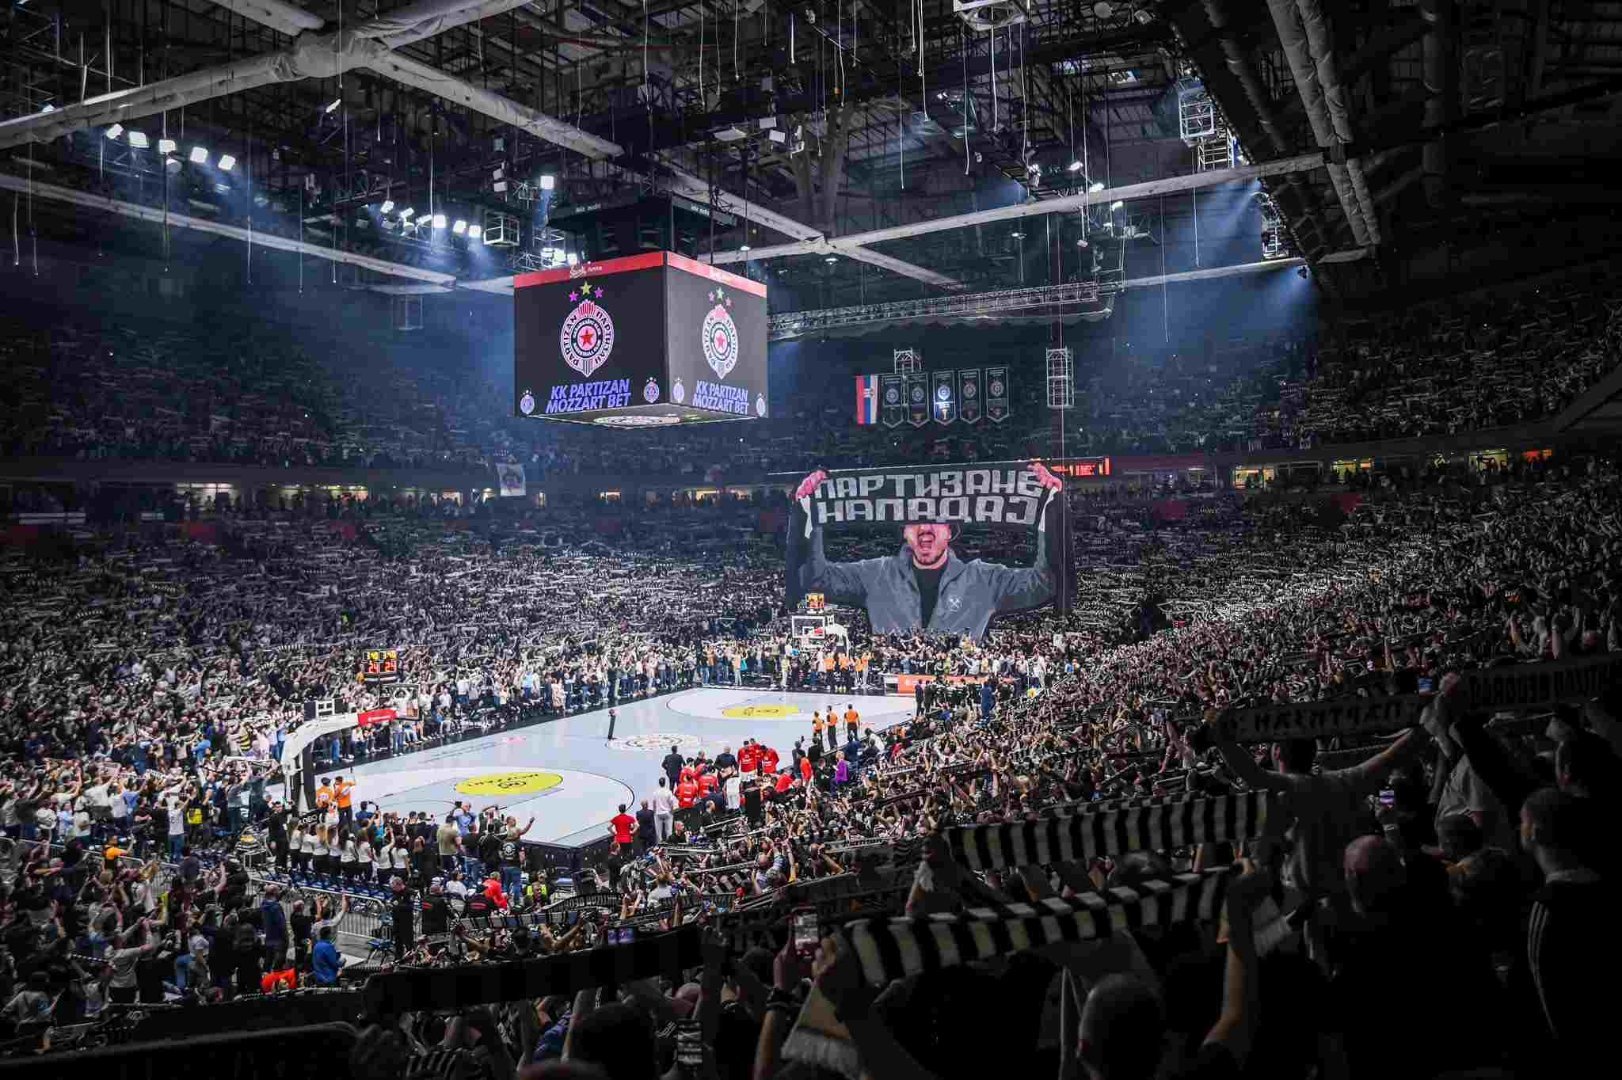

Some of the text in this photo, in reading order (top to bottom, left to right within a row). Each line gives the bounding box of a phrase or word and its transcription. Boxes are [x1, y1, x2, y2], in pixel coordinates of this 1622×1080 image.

[564, 315, 580, 366] PARTIZAN
[551, 379, 630, 400] KK PARTIZAN
[696, 380, 748, 402] KK PARTIZAN
[545, 392, 631, 414] MOZZART BET
[692, 393, 749, 415] MOZZART BET
[814, 469, 1043, 499] ПАРТИЗАНЕ
[817, 495, 1039, 525] НАПАДАЈ
